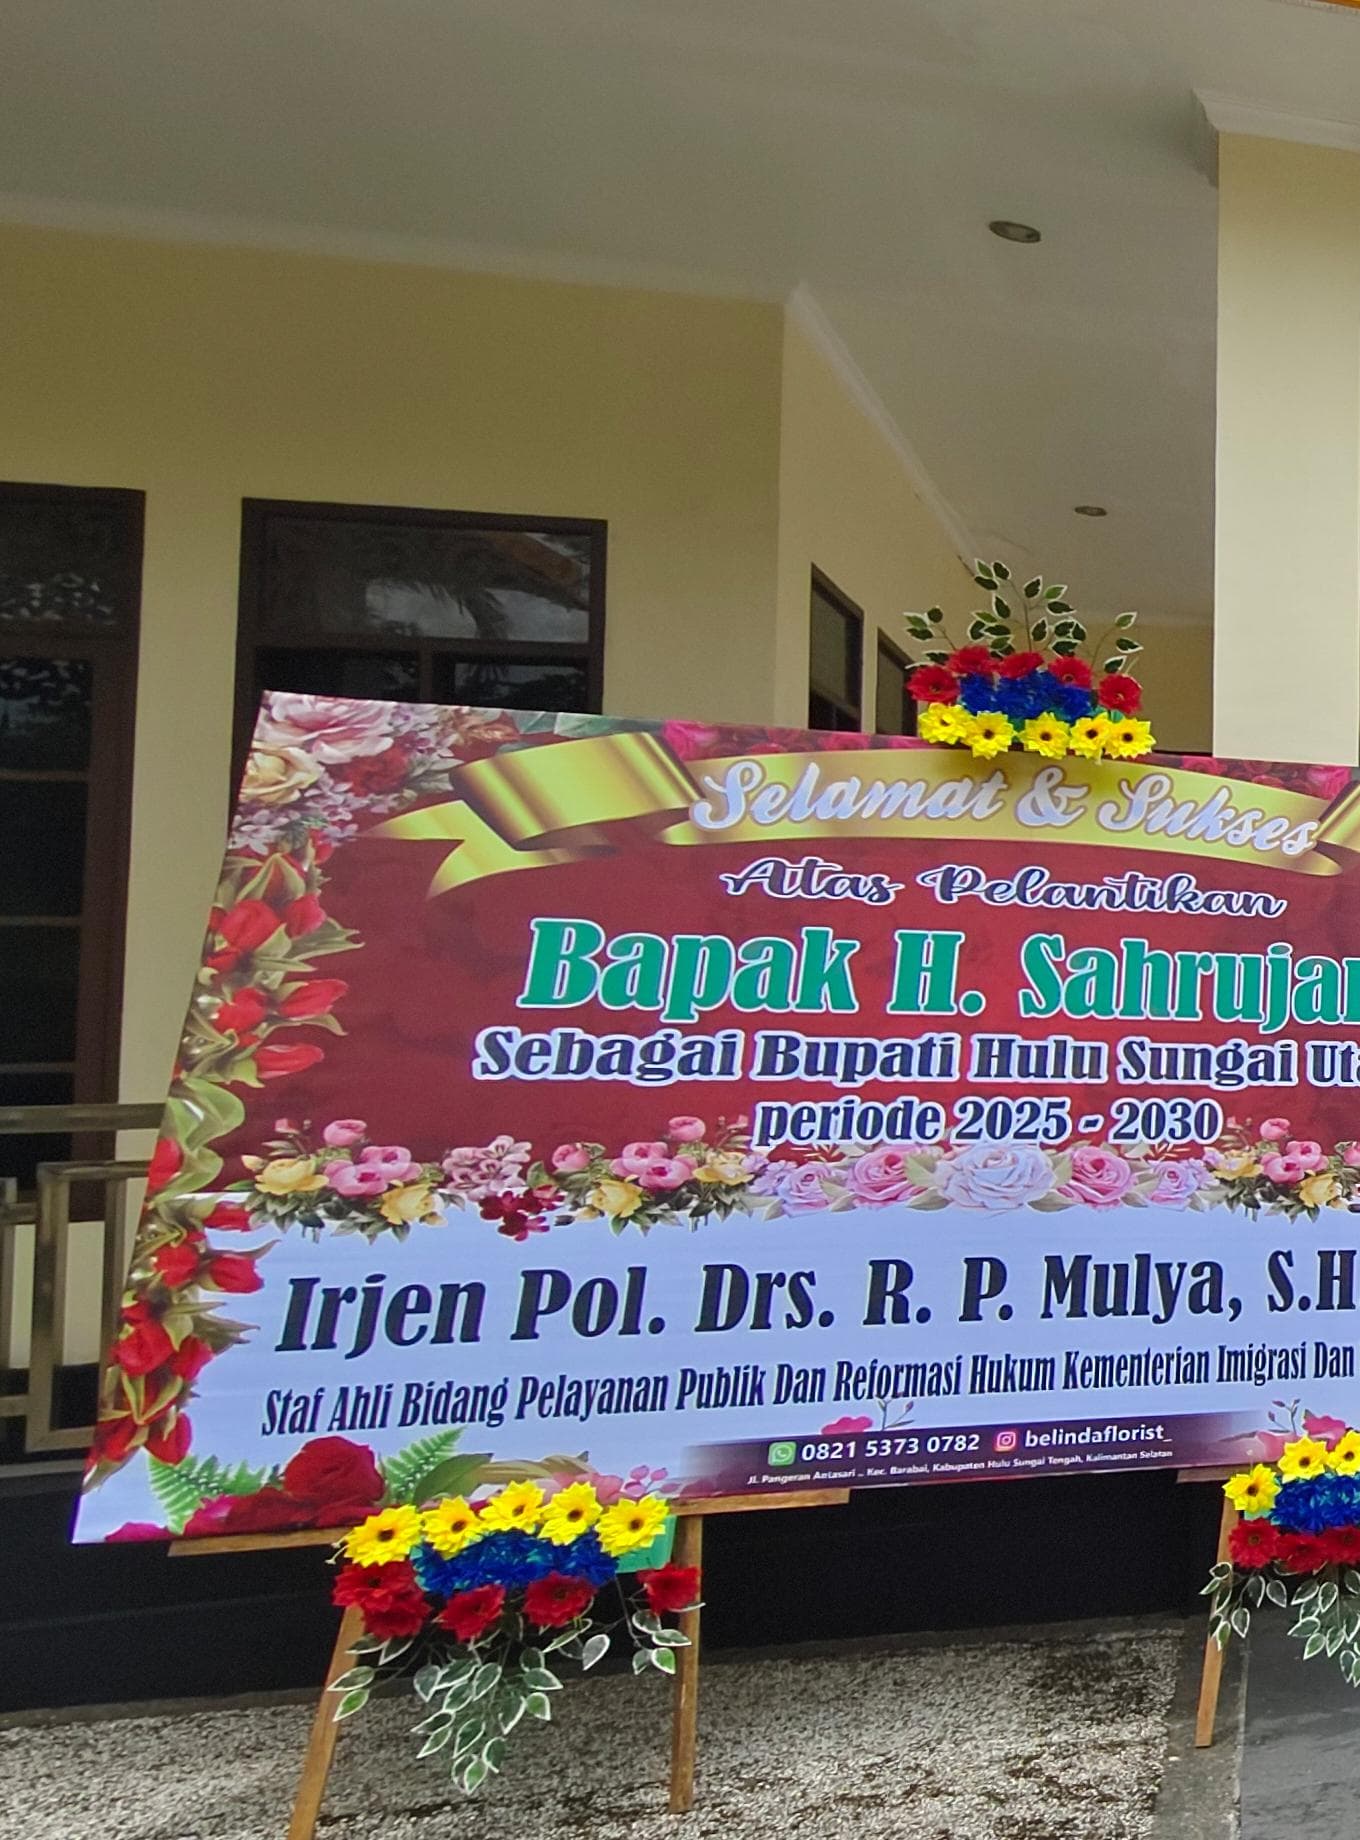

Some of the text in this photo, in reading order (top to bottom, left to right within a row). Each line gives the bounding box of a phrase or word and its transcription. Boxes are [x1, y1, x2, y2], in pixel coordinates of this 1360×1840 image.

[690, 759, 1322, 856] Selamat & Sukses
[720, 855, 1288, 918] Atas Pelantikan
[517, 917, 856, 1023] Bapak
[888, 929, 986, 1017] H.
[472, 1028, 742, 1083] Sebagai
[751, 1030, 962, 1089] Bupati
[967, 1033, 1111, 1084] Hulu
[1116, 1035, 1302, 1090] Sungai
[752, 1096, 1226, 1148] periode 2025 - 2030
[274, 1272, 488, 1360] Irjen
[510, 1265, 667, 1341] Pol.
[694, 1261, 836, 1334] Drs.
[862, 1257, 933, 1326] R.
[958, 1255, 1014, 1322] P.
[1040, 1251, 1244, 1326] Mulya,
[260, 1388, 327, 1437] Staf
[328, 1384, 392, 1432] Ahli
[396, 1377, 510, 1429] Bidang
[514, 1371, 670, 1424] Pelayanan
[674, 1365, 766, 1411] Publik
[770, 1362, 829, 1407] Dan
[832, 1351, 963, 1403] Reformasi
[968, 1351, 1058, 1397] Hukum
[1062, 1341, 1212, 1391] Kementerian
[1215, 1338, 1310, 1385] Imigrasi
[1312, 1340, 1357, 1380] Dan
[761, 1471, 812, 1485] Pangeran
[812, 1469, 856, 1481] Antasari
[866, 1467, 887, 1477] Kec.
[889, 1464, 930, 1475] Barabai,
[932, 1459, 985, 1473] Kabupaten
[987, 1459, 1011, 1469] Hulu
[1012, 1456, 1046, 1469] Sungai
[1047, 1454, 1084, 1467] Tengah,
[1085, 1451, 1138, 1463] Kalimantan
[1139, 1449, 1173, 1459] Selatan
[801, 1433, 981, 1462] 0821 5373 0782
[1024, 1423, 1173, 1449] belindaflorist_
